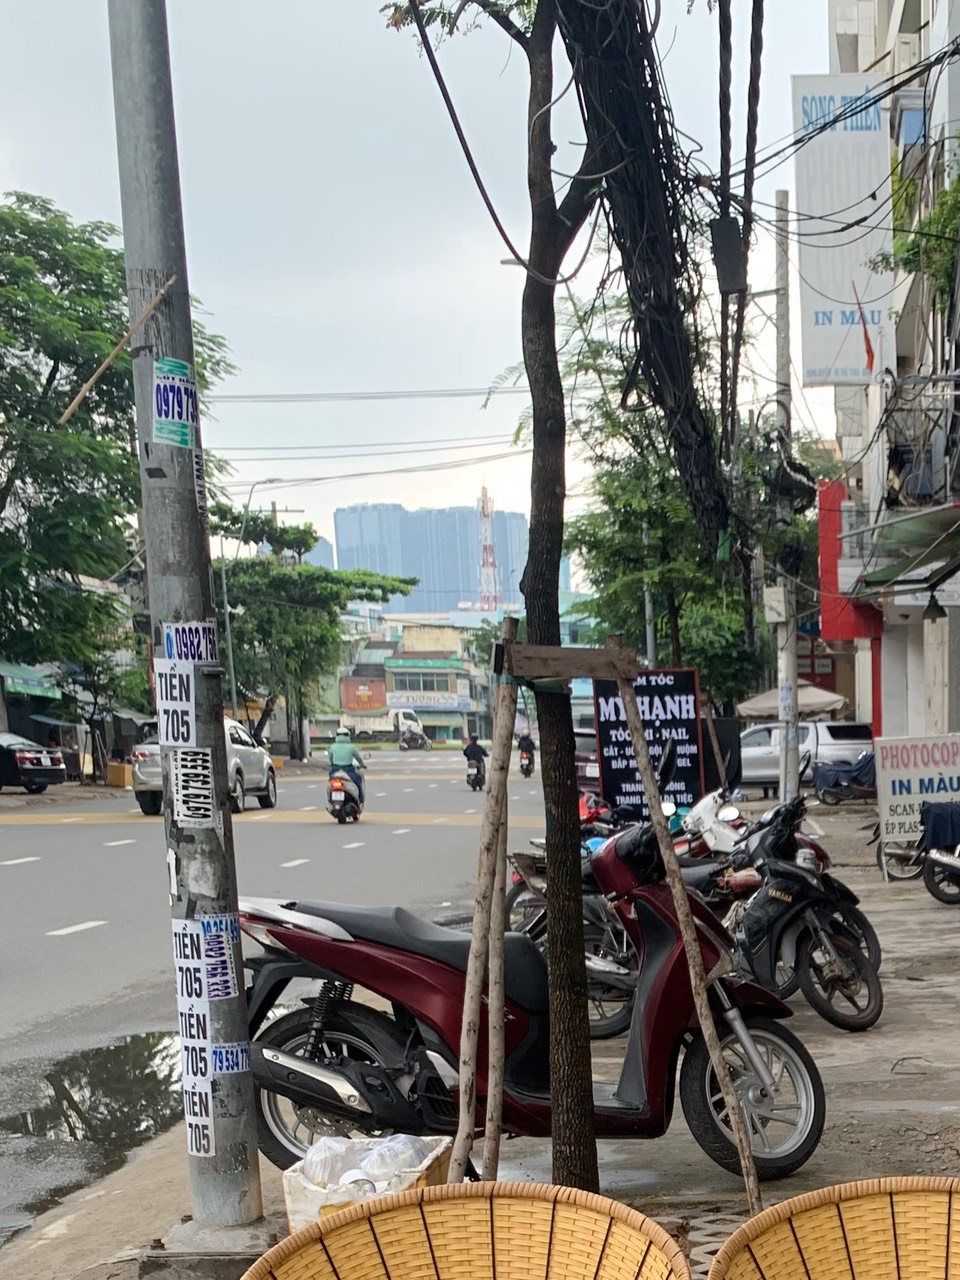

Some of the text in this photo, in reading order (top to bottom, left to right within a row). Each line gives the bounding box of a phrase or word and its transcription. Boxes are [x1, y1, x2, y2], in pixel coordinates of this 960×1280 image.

[802, 85, 882, 133] SONG THIÊN
[814, 311, 834, 326] IN
[650, 673, 674, 685] TÓC
[163, 708, 190, 743] 705
[662, 728, 689, 741] NAIL
[891, 779, 912, 796] IN
[885, 819, 896, 835] ÉP
[768, 888, 792, 903] YAMAHA
[178, 966, 202, 999] 705
[184, 1046, 208, 1077] 705
[225, 1049, 240, 1071] 534
[188, 1123, 211, 1154] 705
